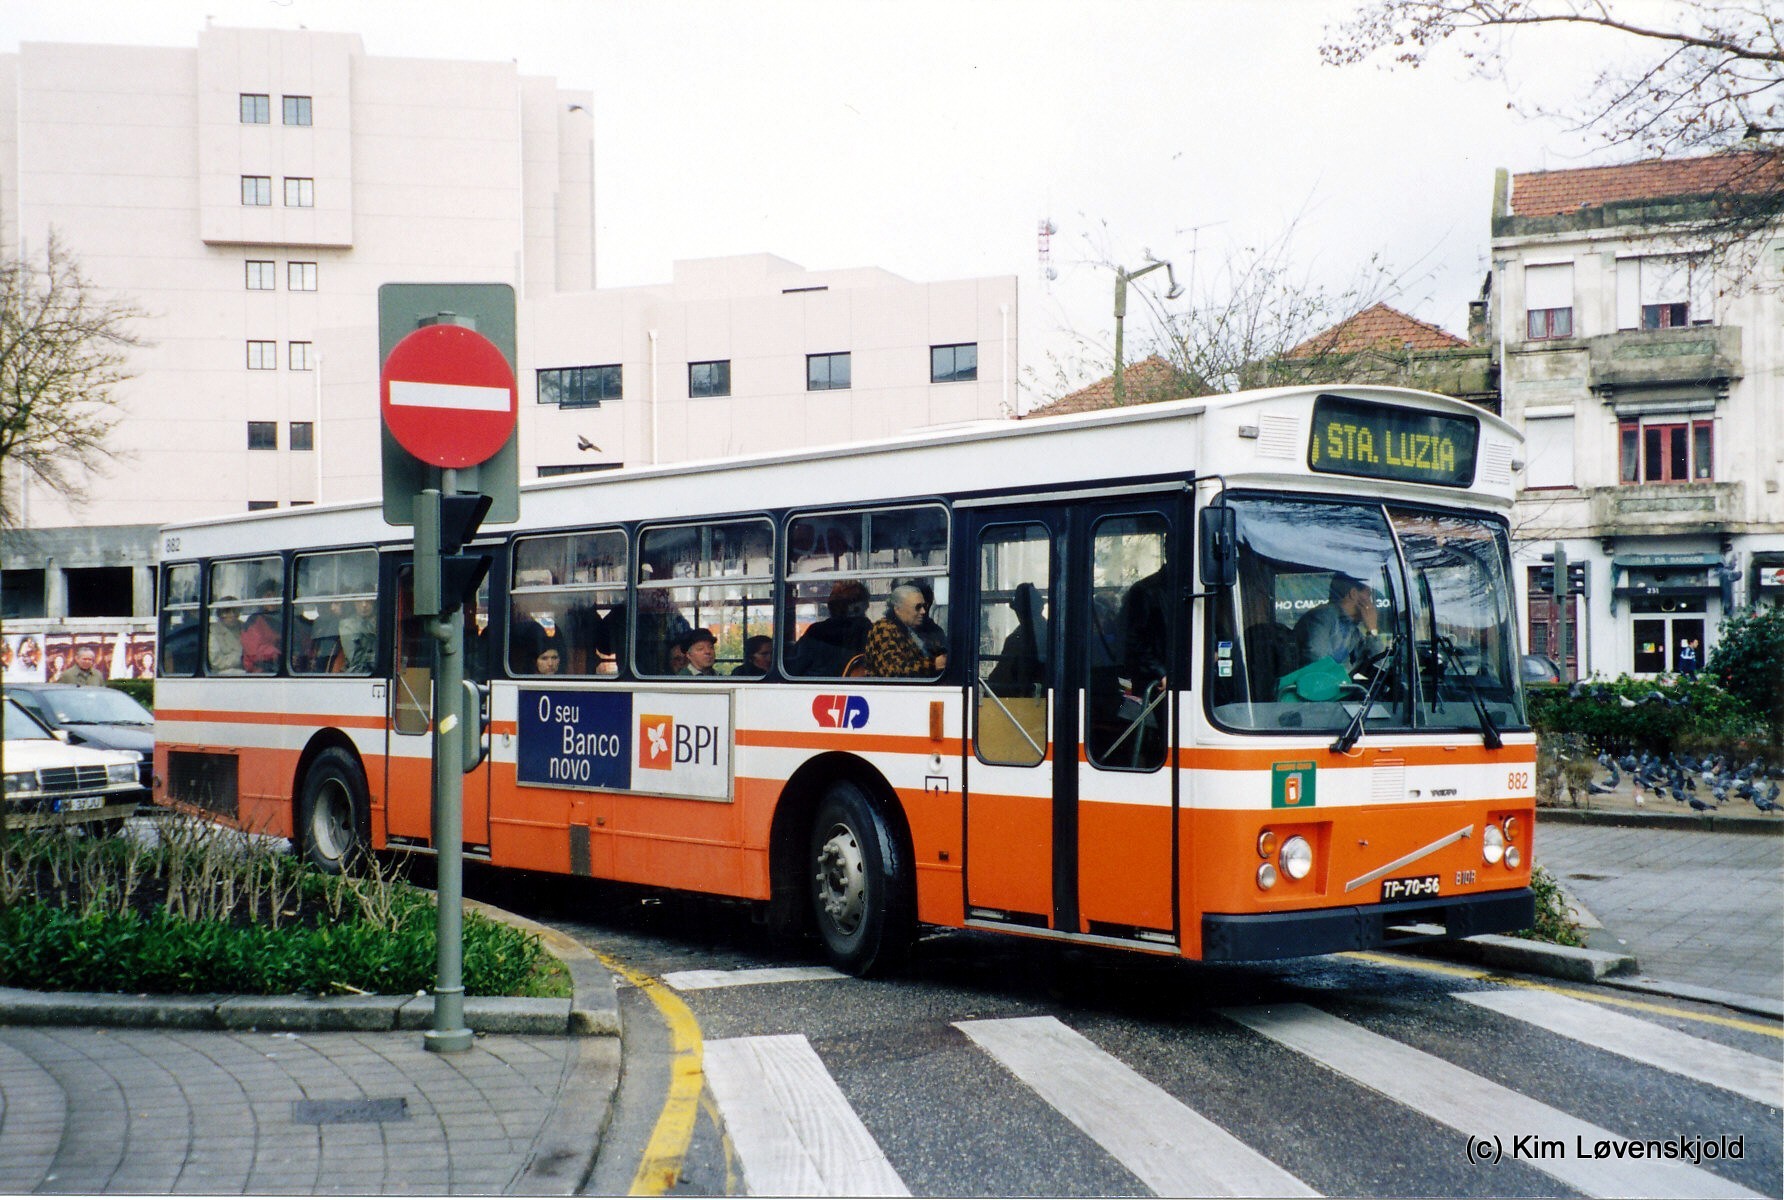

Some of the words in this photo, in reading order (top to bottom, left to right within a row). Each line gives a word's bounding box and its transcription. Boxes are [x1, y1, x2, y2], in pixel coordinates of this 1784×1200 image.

[1327, 422, 1379, 463] STA.
[1385, 430, 1455, 472] LUZIA
[166, 537, 181, 553] 882
[538, 695, 551, 723] O
[555, 704, 580, 724] seu
[562, 725, 620, 758] Banco
[674, 723, 719, 766] BPI
[549, 756, 591, 782] novo
[1507, 771, 1528, 790] 882
[1383, 877, 1440, 899] TP-70-56
